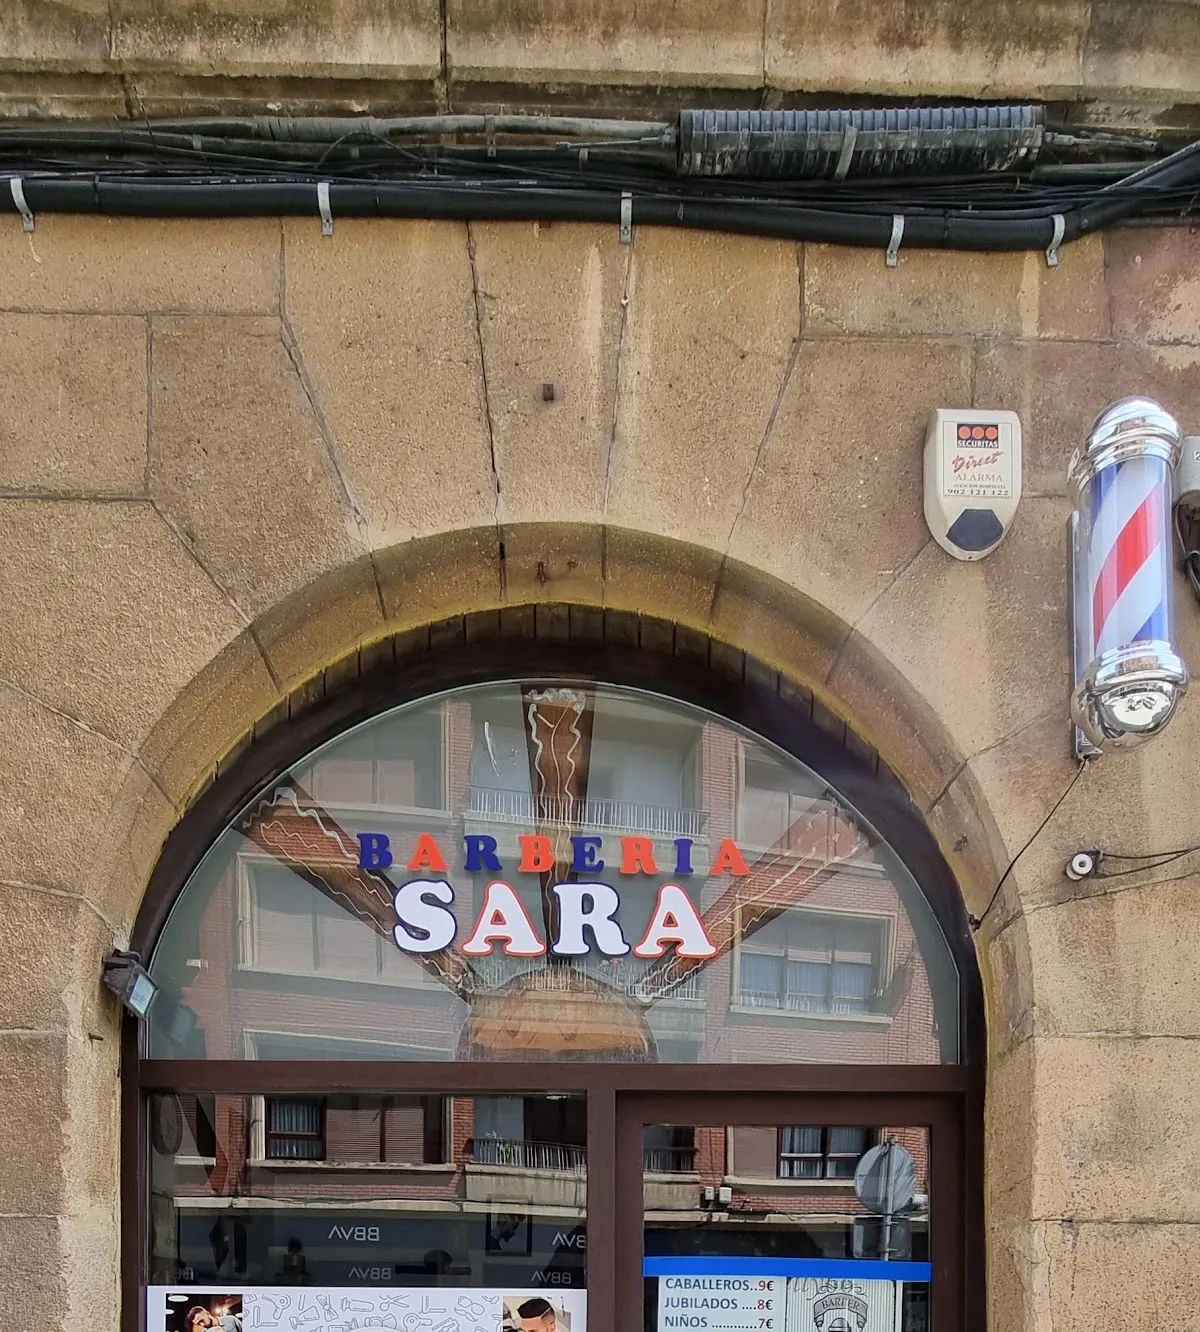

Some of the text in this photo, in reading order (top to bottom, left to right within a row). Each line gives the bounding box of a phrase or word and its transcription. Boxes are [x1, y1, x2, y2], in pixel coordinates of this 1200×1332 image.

[957, 440, 998, 448] SECURITAS
[952, 451, 1004, 473] Direct
[956, 474, 1003, 482] ALARMA
[357, 833, 751, 876] BARBERIA
[393, 879, 719, 959] SARA
[664, 1297, 738, 1310] JUBILADOS
[821, 1297, 861, 1310] BARBER
[664, 1314, 708, 1328] NIÑOS
